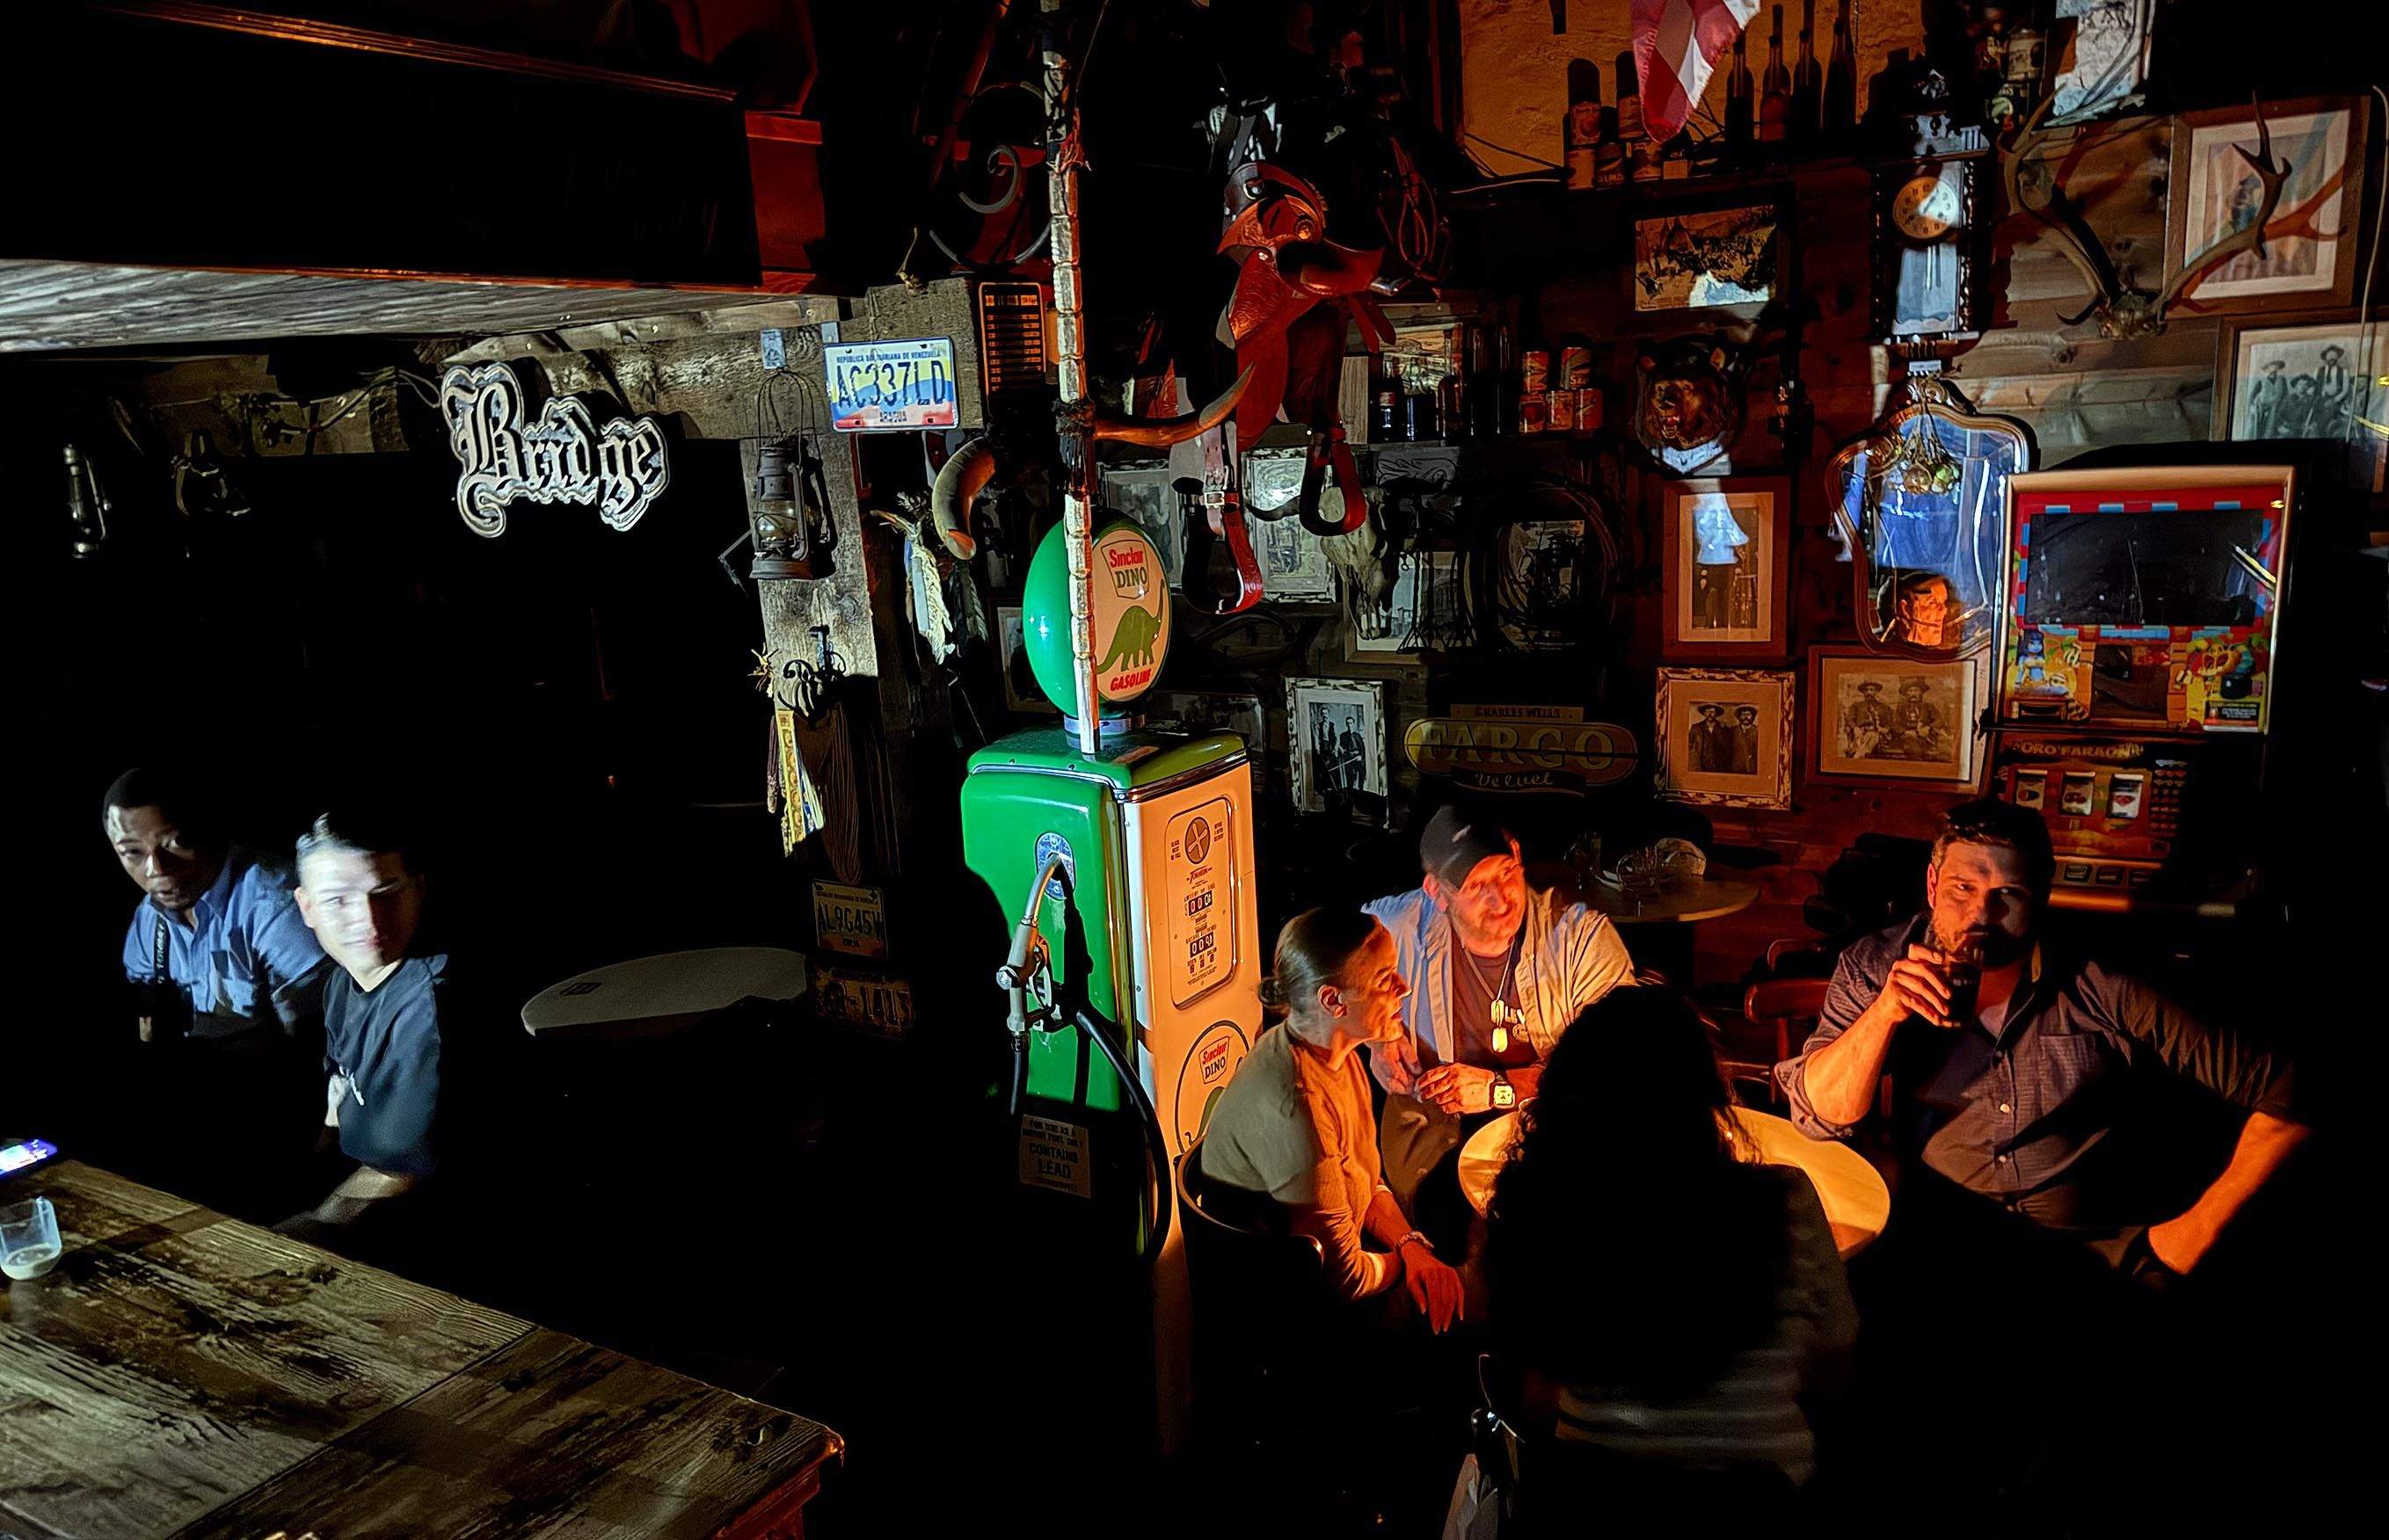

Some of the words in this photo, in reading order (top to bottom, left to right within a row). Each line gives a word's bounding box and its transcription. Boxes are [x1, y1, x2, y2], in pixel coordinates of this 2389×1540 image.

[836, 355, 864, 364] REPUBLICA
[836, 360, 946, 409] AC337LD
[441, 366, 668, 537] Bridge
[1109, 547, 1144, 569] Sinclair
[1114, 566, 1148, 589] DINO
[1110, 668, 1153, 692] GASOLINE
[1205, 1056, 1226, 1079] DINO
[1038, 1158, 1072, 1179] LEAD
